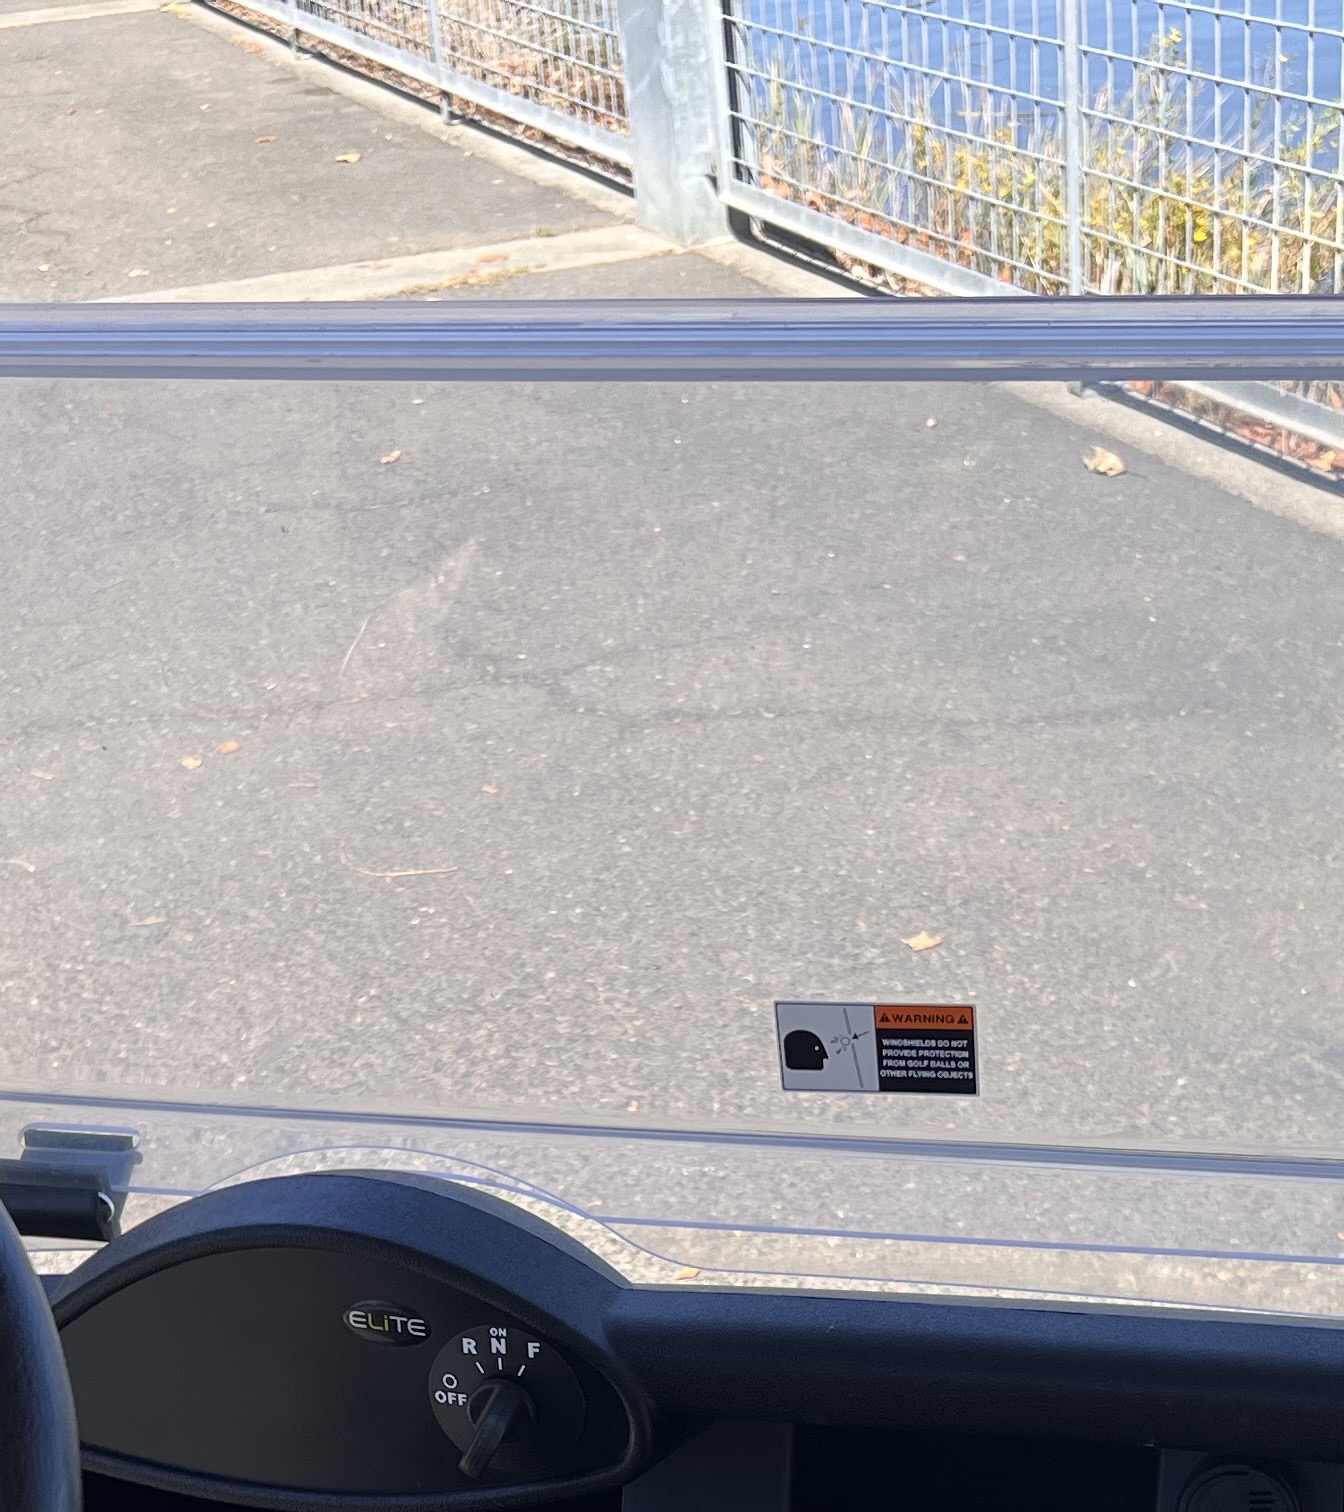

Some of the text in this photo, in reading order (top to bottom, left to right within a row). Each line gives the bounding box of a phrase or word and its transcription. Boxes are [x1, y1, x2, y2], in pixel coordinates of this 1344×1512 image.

[892, 1014, 954, 1023] WARNING
[882, 1039, 936, 1047] WINDSHIELDS
[937, 1039, 950, 1047] DO
[882, 1049, 969, 1058] PROVIDE PROTECTION
[882, 1059, 906, 1067] FROM
[930, 1060, 956, 1068] BALLS
[908, 1070, 936, 1078] FLYING
[937, 1071, 973, 1079] OBJECTS
[489, 1327, 507, 1337] ON
[462, 1337, 541, 1359] R N F
[434, 1390, 468, 1406] OFF
